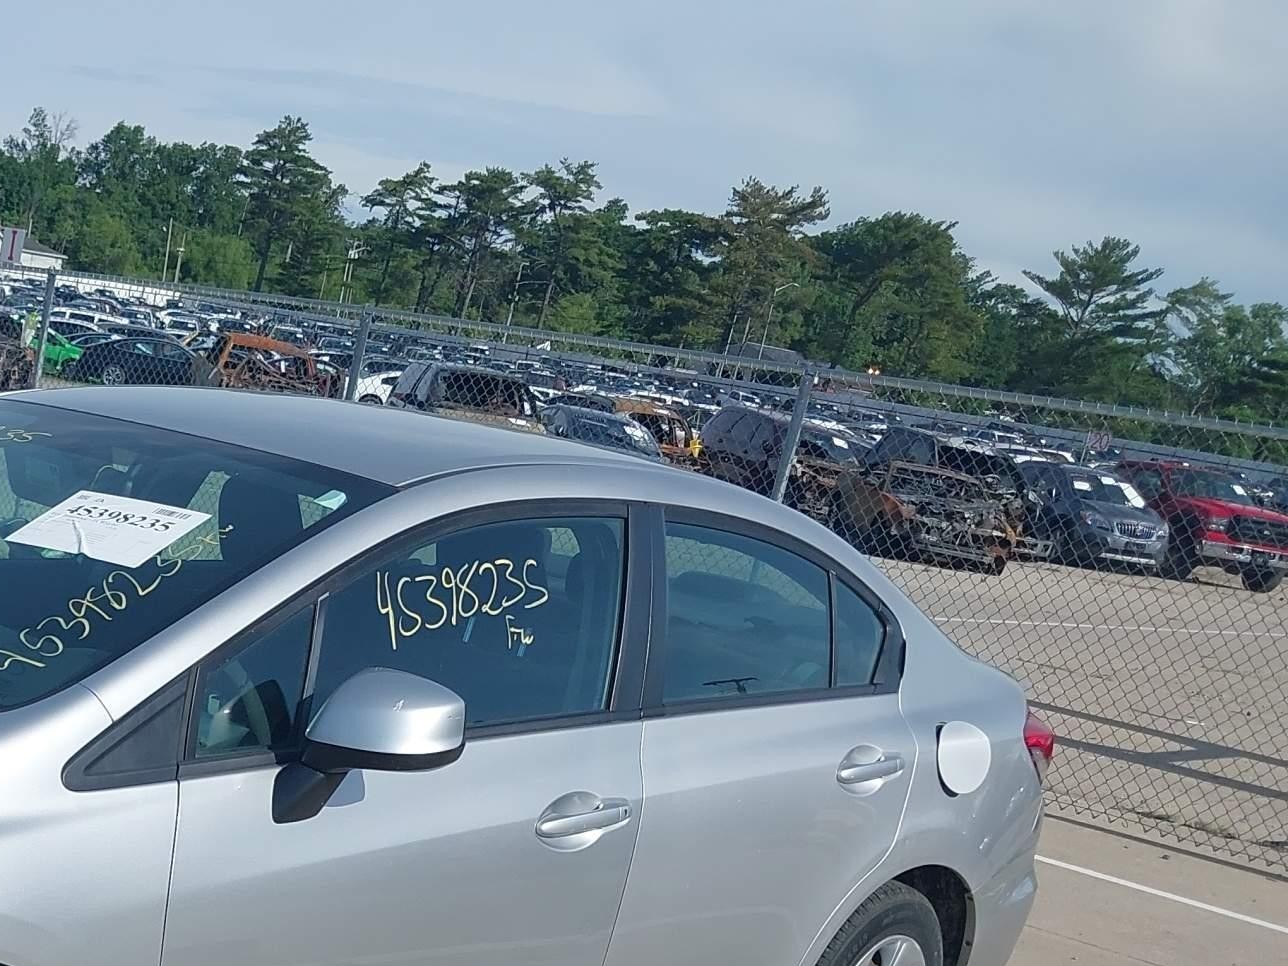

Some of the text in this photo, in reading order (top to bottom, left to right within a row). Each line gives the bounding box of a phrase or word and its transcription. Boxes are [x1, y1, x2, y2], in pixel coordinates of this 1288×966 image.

[1090, 432, 1110, 450] 20
[67, 504, 177, 532] 45398235
[377, 559, 548, 650] 45398235
